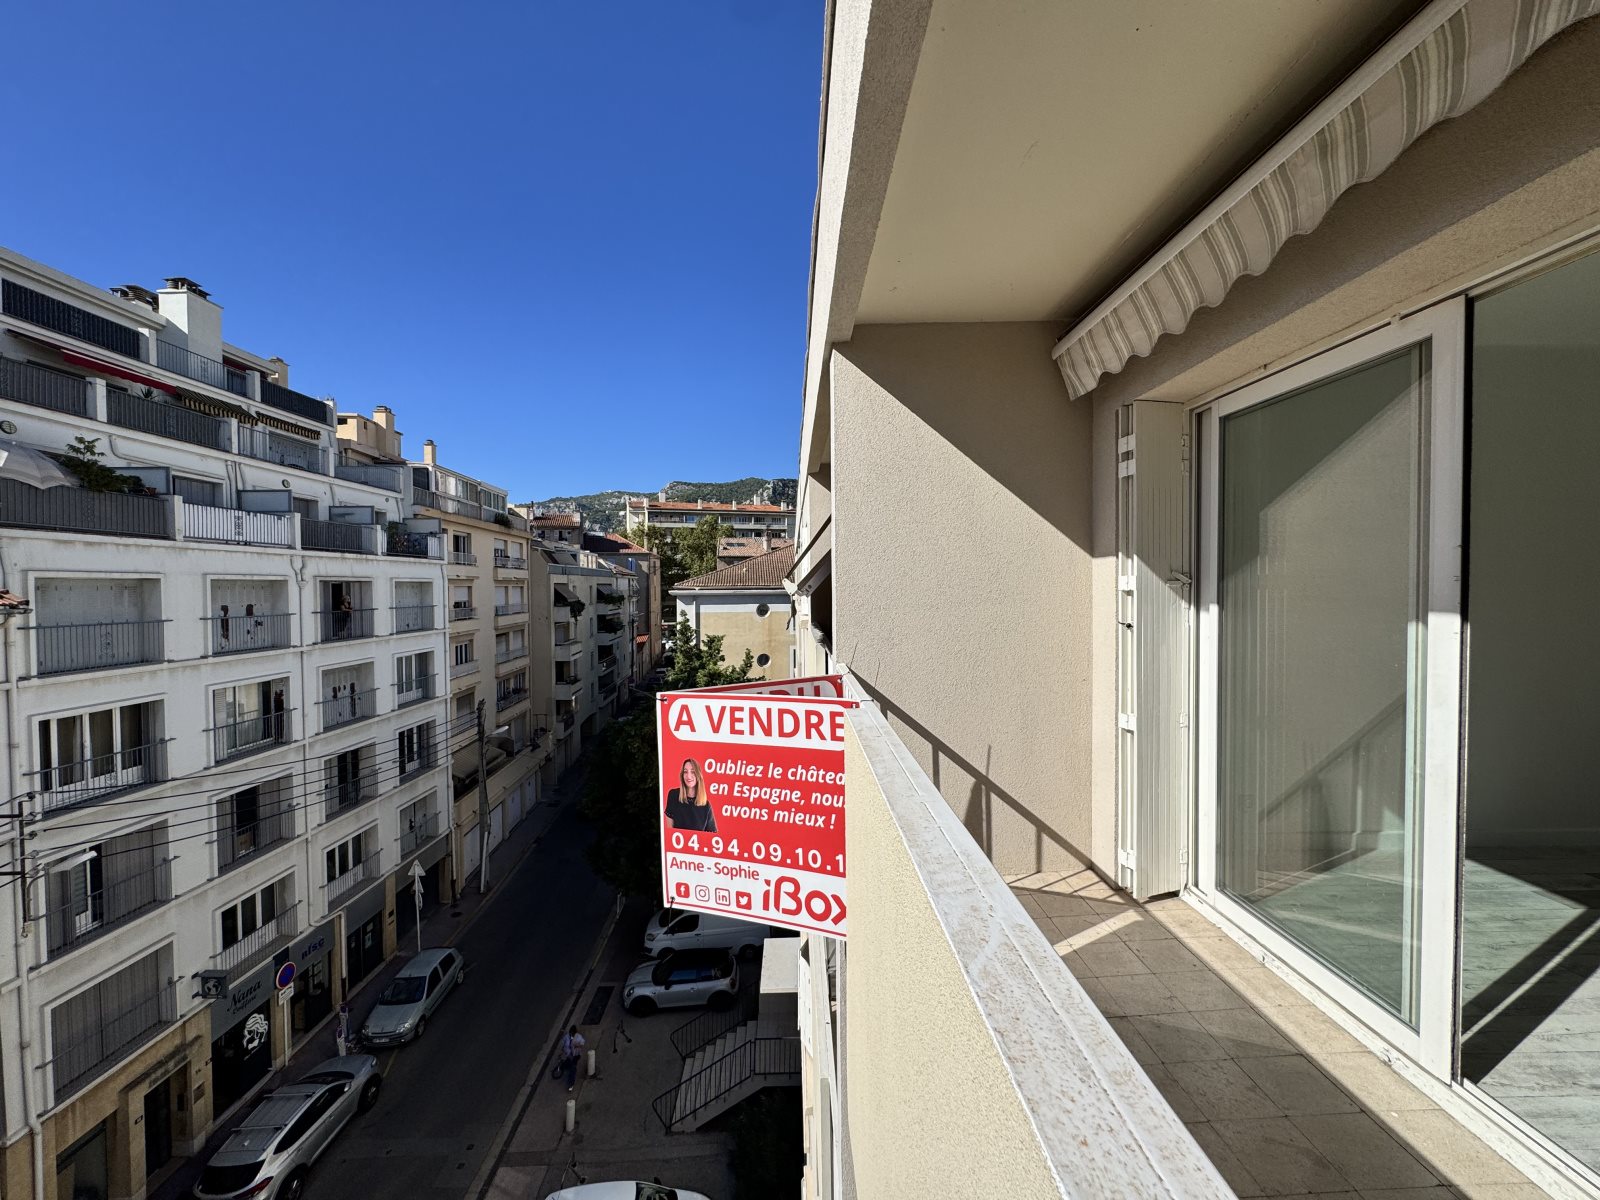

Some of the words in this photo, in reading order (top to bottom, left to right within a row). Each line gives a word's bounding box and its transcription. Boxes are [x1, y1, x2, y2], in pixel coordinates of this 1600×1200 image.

[673, 704, 696, 733] A
[705, 705, 845, 742] VENDRE
[704, 758, 763, 778] Oubliez
[767, 762, 783, 779] le
[709, 783, 728, 796] en
[733, 782, 805, 806] Espagne,
[811, 791, 846, 808] nou
[722, 804, 769, 821] avons
[774, 807, 826, 828] mieux
[670, 856, 704, 873] Anne
[714, 862, 760, 881] Sophie
[227, 980, 262, 1012] Nana
